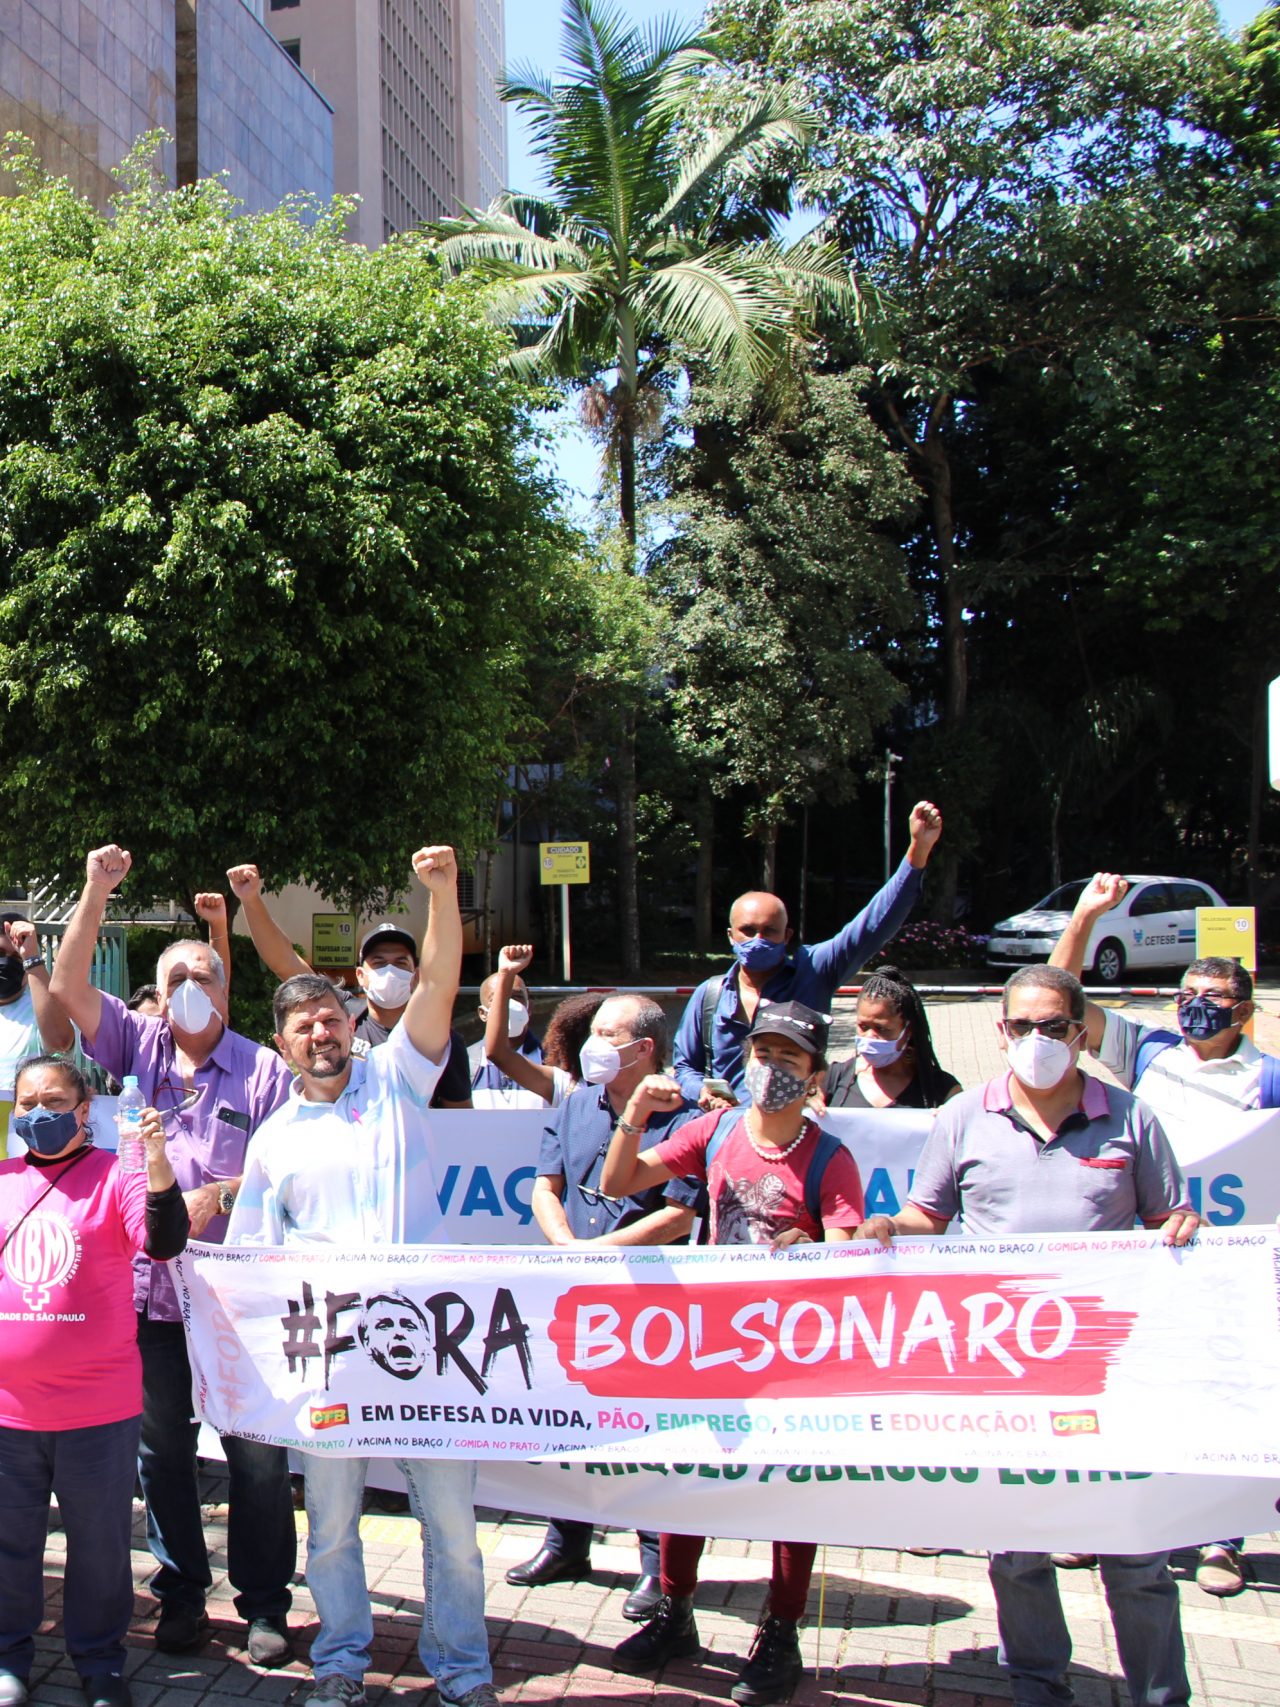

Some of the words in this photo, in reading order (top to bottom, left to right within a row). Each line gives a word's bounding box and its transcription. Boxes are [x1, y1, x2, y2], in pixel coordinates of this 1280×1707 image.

[339, 923, 351, 933] 10
[1145, 934, 1177, 946] CETESB
[6, 1219, 67, 1283] UBM
[185, 1248, 210, 1260] VACINA
[213, 1252, 225, 1261] NO
[226, 1253, 251, 1263] BRAÇO
[335, 1253, 367, 1263] VACINA
[370, 1254, 384, 1262] NO
[387, 1254, 419, 1263] BRAÇO
[431, 1254, 466, 1263] COMIDA
[470, 1254, 484, 1263] NO
[486, 1255, 517, 1264] PRATO
[528, 1255, 563, 1264] VACINA
[566, 1255, 581, 1264] NO
[629, 1254, 664, 1263] COMIDA
[730, 1253, 765, 1262] VACINA
[770, 1252, 784, 1261] NO
[788, 1251, 821, 1262] BRAÇO
[833, 1247, 871, 1259] COMIDA
[874, 1245, 889, 1255] NO
[892, 1245, 926, 1255] PRATO
[937, 1244, 976, 1254] VACINA
[980, 1244, 996, 1253] NO
[999, 1243, 1035, 1254] BRAÇO
[1047, 1241, 1088, 1252] COMIDA
[1092, 1241, 1108, 1250] NO
[1111, 1240, 1147, 1250] PRATO
[1207, 1237, 1223, 1246] NO
[1228, 1235, 1266, 1247] BRAÇO
[22, 1312, 34, 1322] DE
[35, 1311, 55, 1322] SÃO
[56, 1313, 86, 1322] PAULO
[568, 1290, 1077, 1379] BOLSONARO
[361, 1405, 393, 1421] EM
[401, 1404, 486, 1424] DEFESA
[491, 1406, 524, 1425] DA
[528, 1408, 592, 1431] VIDA,
[598, 1407, 650, 1432] PÃO,
[656, 1413, 777, 1434] EMPREGO,
[784, 1413, 864, 1432] SAUDE
[871, 1414, 884, 1431] E
[890, 1410, 1037, 1437] EDUCAÇÃO!
[273, 1436, 300, 1447] COMIDA
[302, 1440, 314, 1448] NO
[316, 1439, 345, 1449] PRATO
[357, 1437, 392, 1446] VACINA
[395, 1437, 408, 1446] NO
[411, 1437, 443, 1447] BRAÇO
[454, 1439, 489, 1449] COMIDA
[492, 1440, 507, 1450] NO
[509, 1441, 540, 1451] PRATO
[552, 1443, 587, 1452] VACINA
